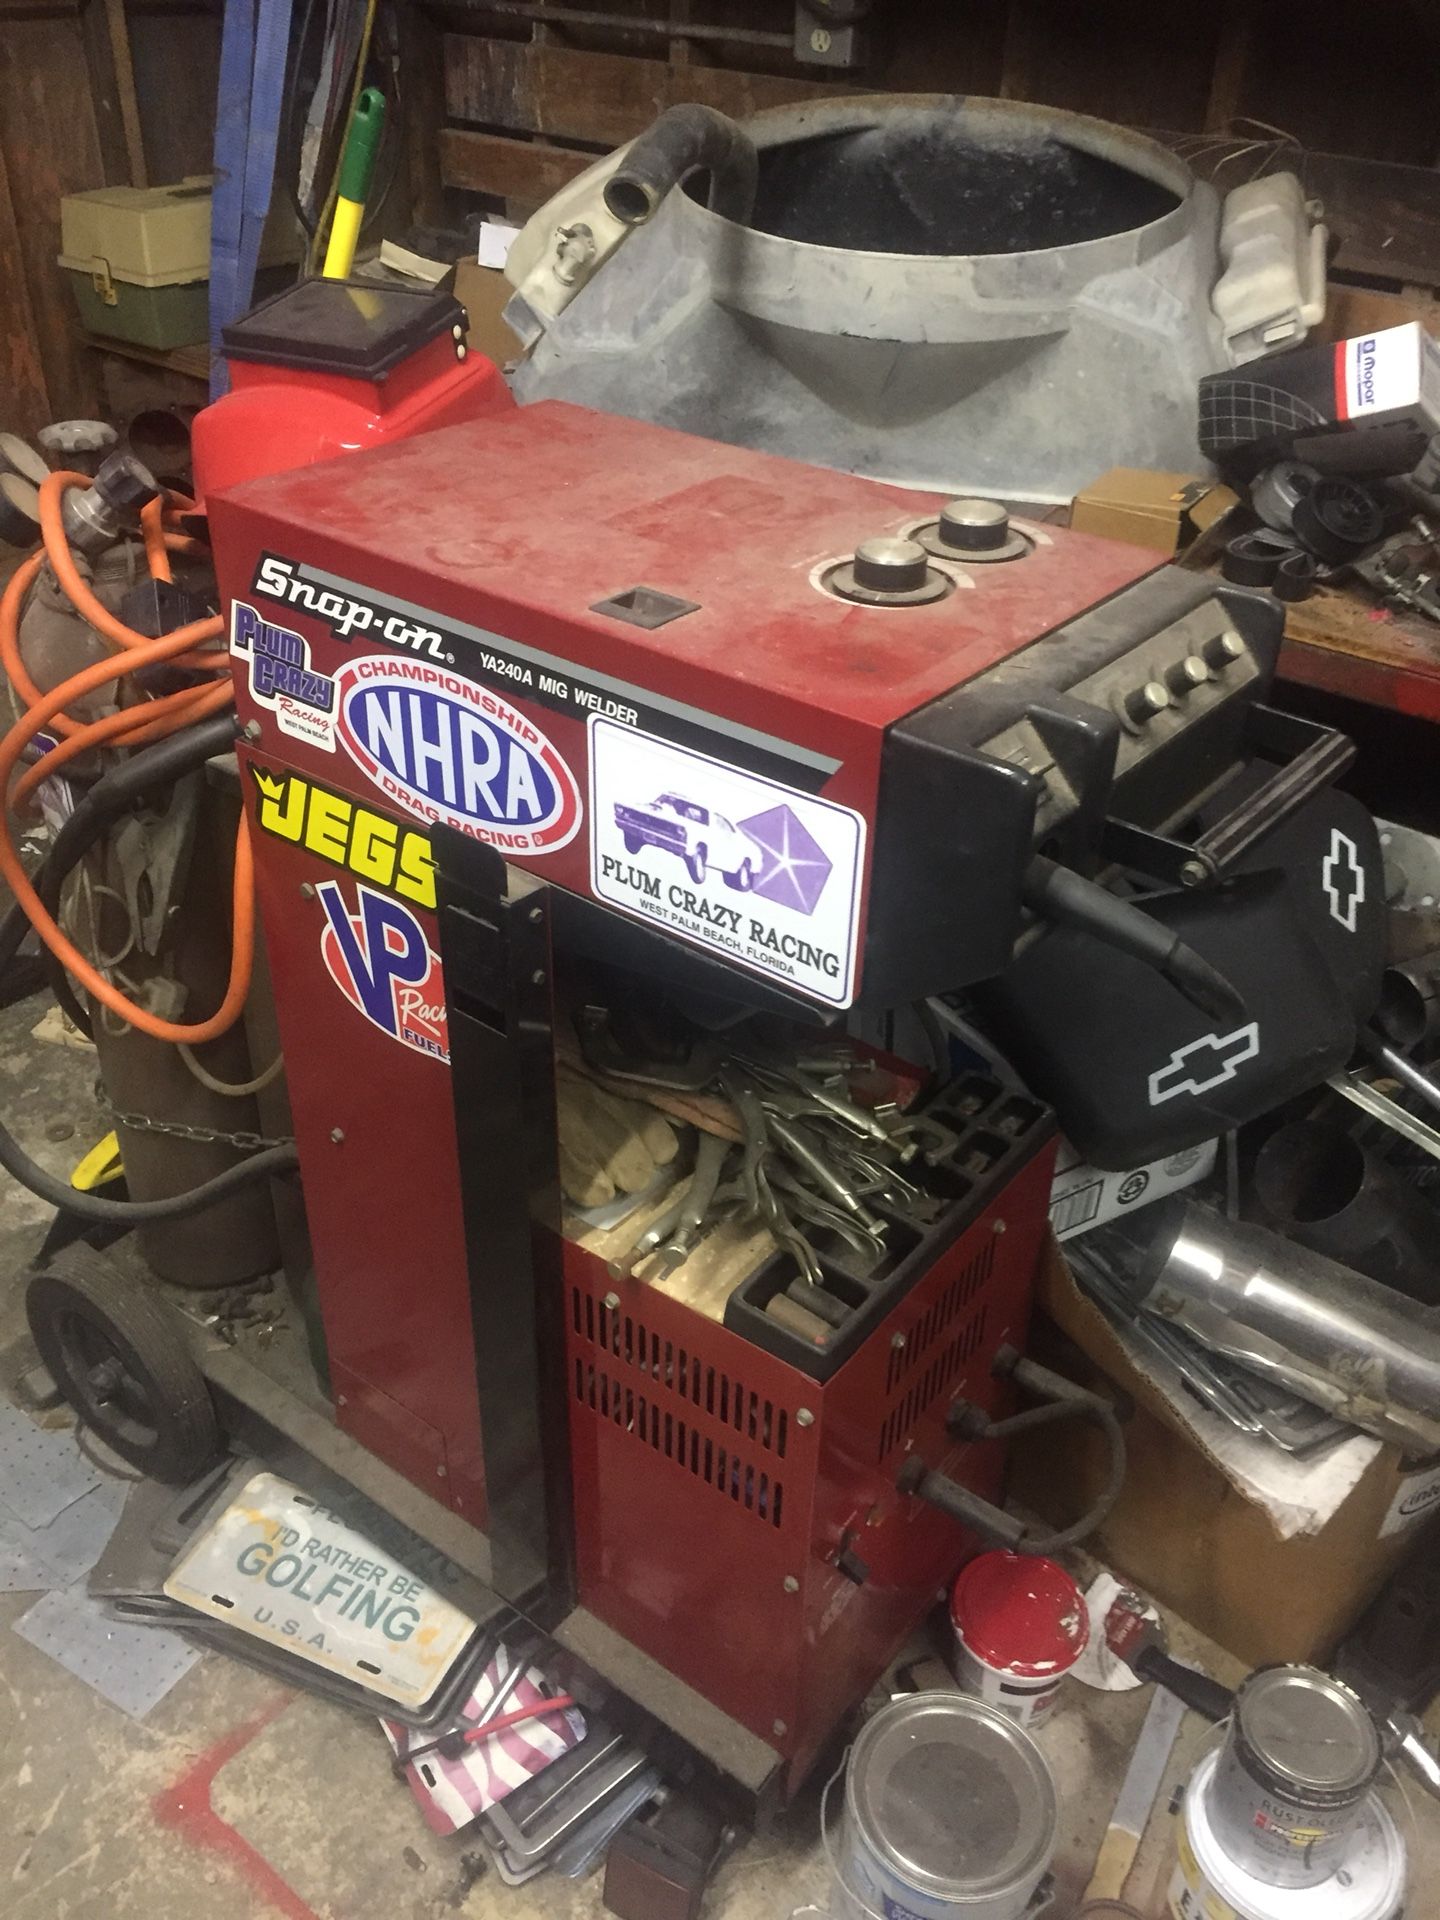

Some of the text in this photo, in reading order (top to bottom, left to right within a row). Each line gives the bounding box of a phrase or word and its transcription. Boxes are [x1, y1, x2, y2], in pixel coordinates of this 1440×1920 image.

[255, 557, 446, 662] Snap-on
[278, 696, 331, 732] Racing
[358, 662, 539, 745] CHAMPIONSHIP
[480, 651, 639, 726] YA240A MIG WELDER
[364, 691, 543, 822] NHRA
[261, 776, 438, 910] JEGS
[383, 775, 529, 849] DRAG RACING
[601, 853, 840, 978] PLUM CRAZY RACING
[639, 898, 796, 976] WEST PALM BEACH, FLORIDA
[316, 881, 431, 1037] VP
[235, 1541, 422, 1642] GOLFING
[271, 1526, 424, 1603] I'D RATHER BE
[253, 1606, 333, 1654] U.S.A.
